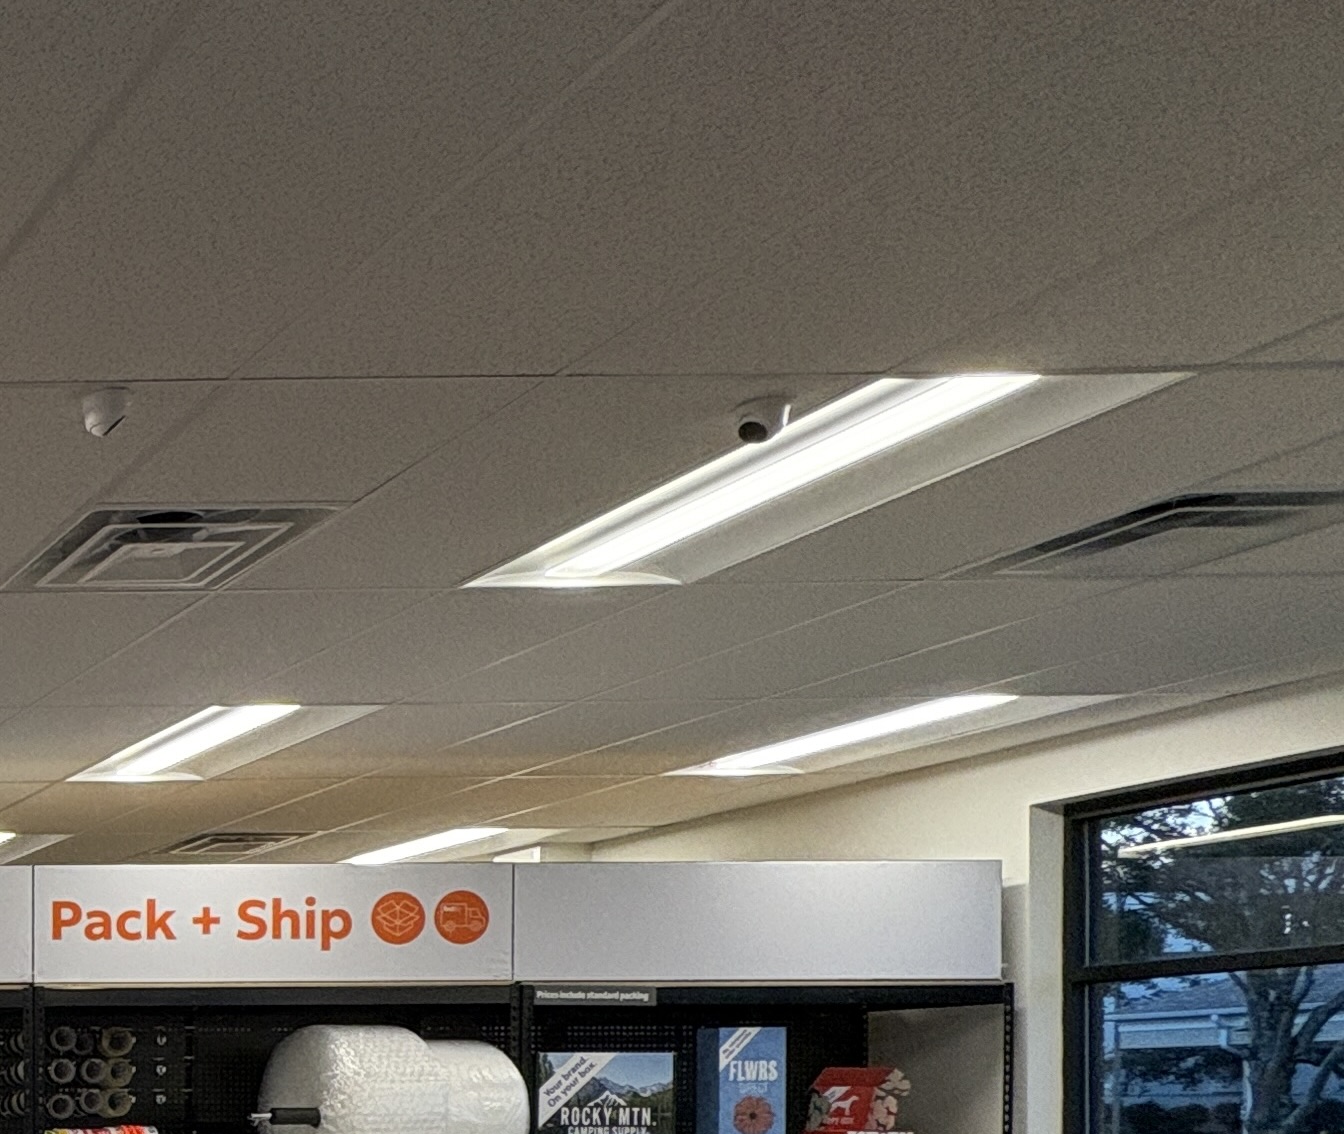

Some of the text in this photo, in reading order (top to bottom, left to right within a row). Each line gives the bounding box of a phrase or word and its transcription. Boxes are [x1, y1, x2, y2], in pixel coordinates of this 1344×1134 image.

[51, 897, 353, 951] Pack + Ship
[536, 991, 649, 1002] Prices include standard packing
[729, 1060, 779, 1081] FLWRS
[543, 1079, 563, 1097] Your
[561, 1077, 580, 1097] your
[560, 1107, 657, 1126] ROCKY MTN.
